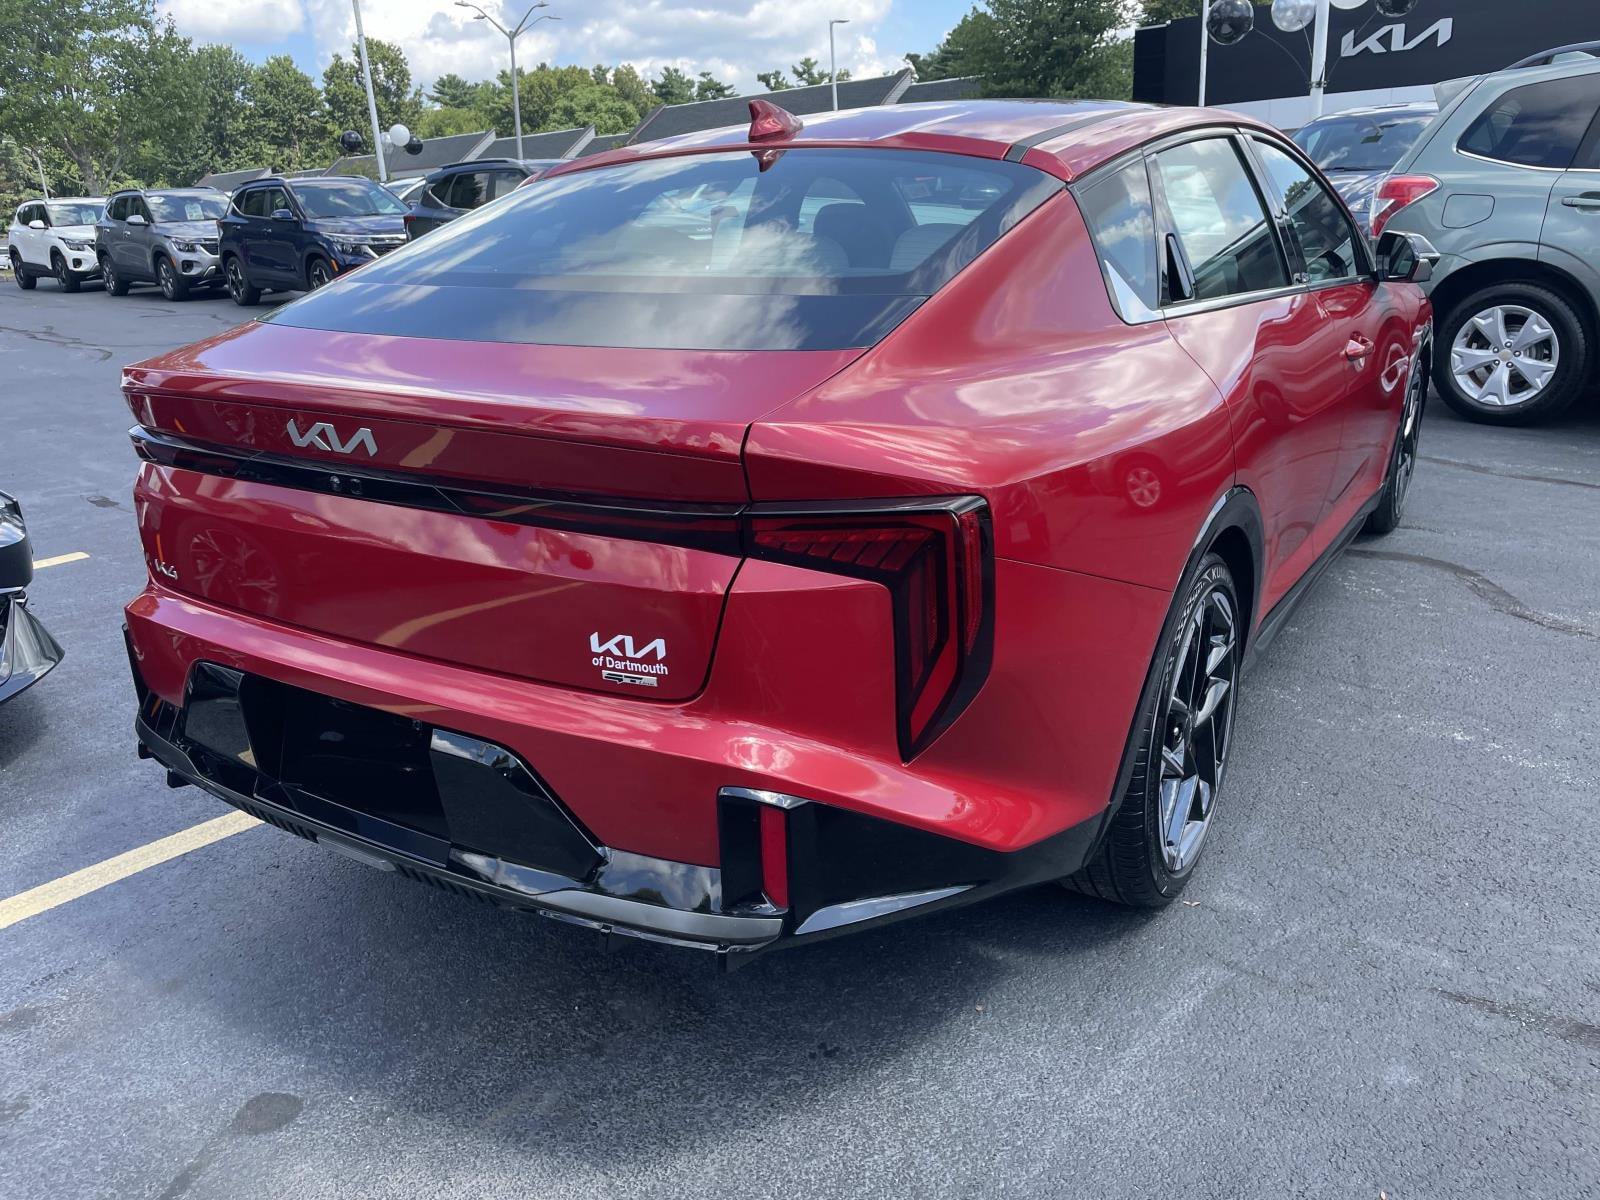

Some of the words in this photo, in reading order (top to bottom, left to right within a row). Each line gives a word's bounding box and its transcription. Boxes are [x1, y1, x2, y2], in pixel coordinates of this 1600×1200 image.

[1340, 17, 1453, 57] KIA
[286, 418, 378, 457] KIA
[589, 631, 667, 661] KIA
[592, 655, 605, 667] of
[605, 656, 669, 675] Dartmouth
